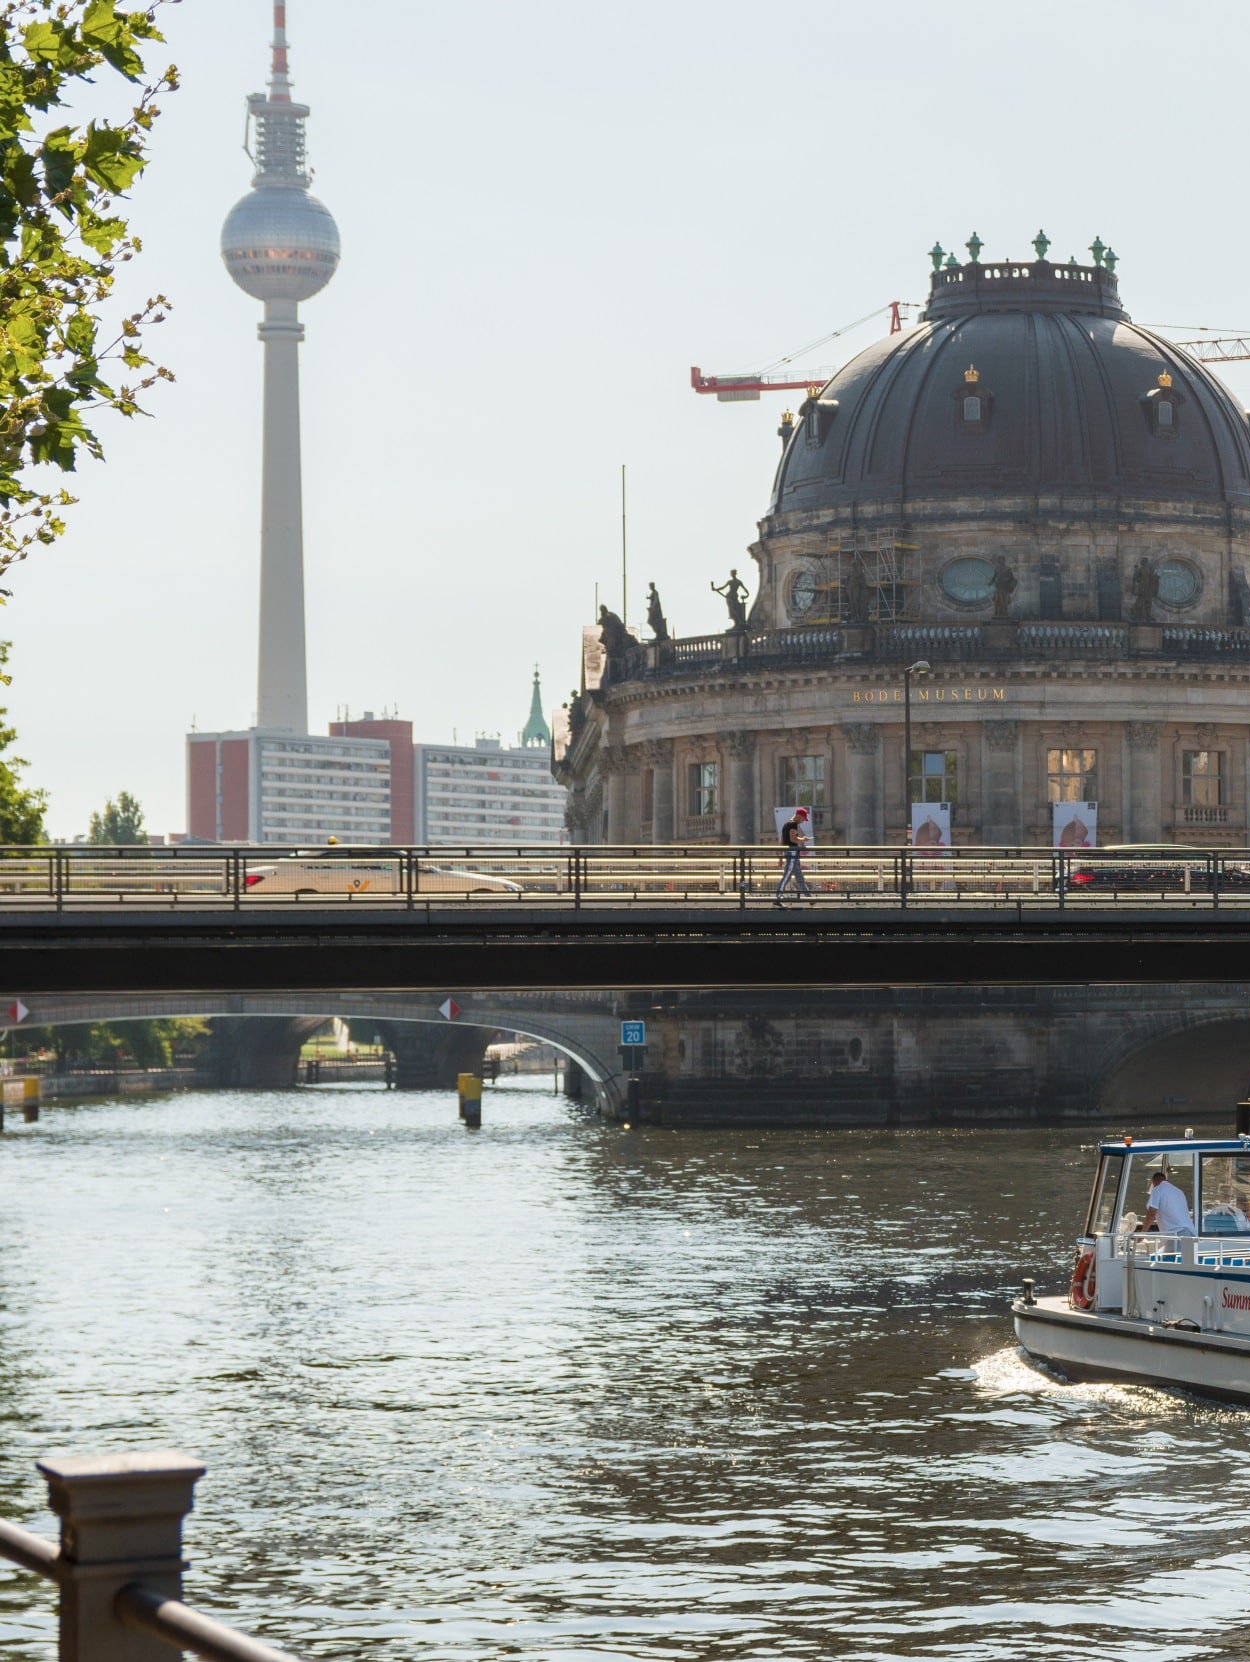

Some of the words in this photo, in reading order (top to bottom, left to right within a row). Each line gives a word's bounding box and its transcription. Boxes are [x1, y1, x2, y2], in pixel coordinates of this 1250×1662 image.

[853, 690, 901, 702] BODE
[919, 688, 1004, 700] MUSEUM
[626, 1031, 640, 1042] 20
